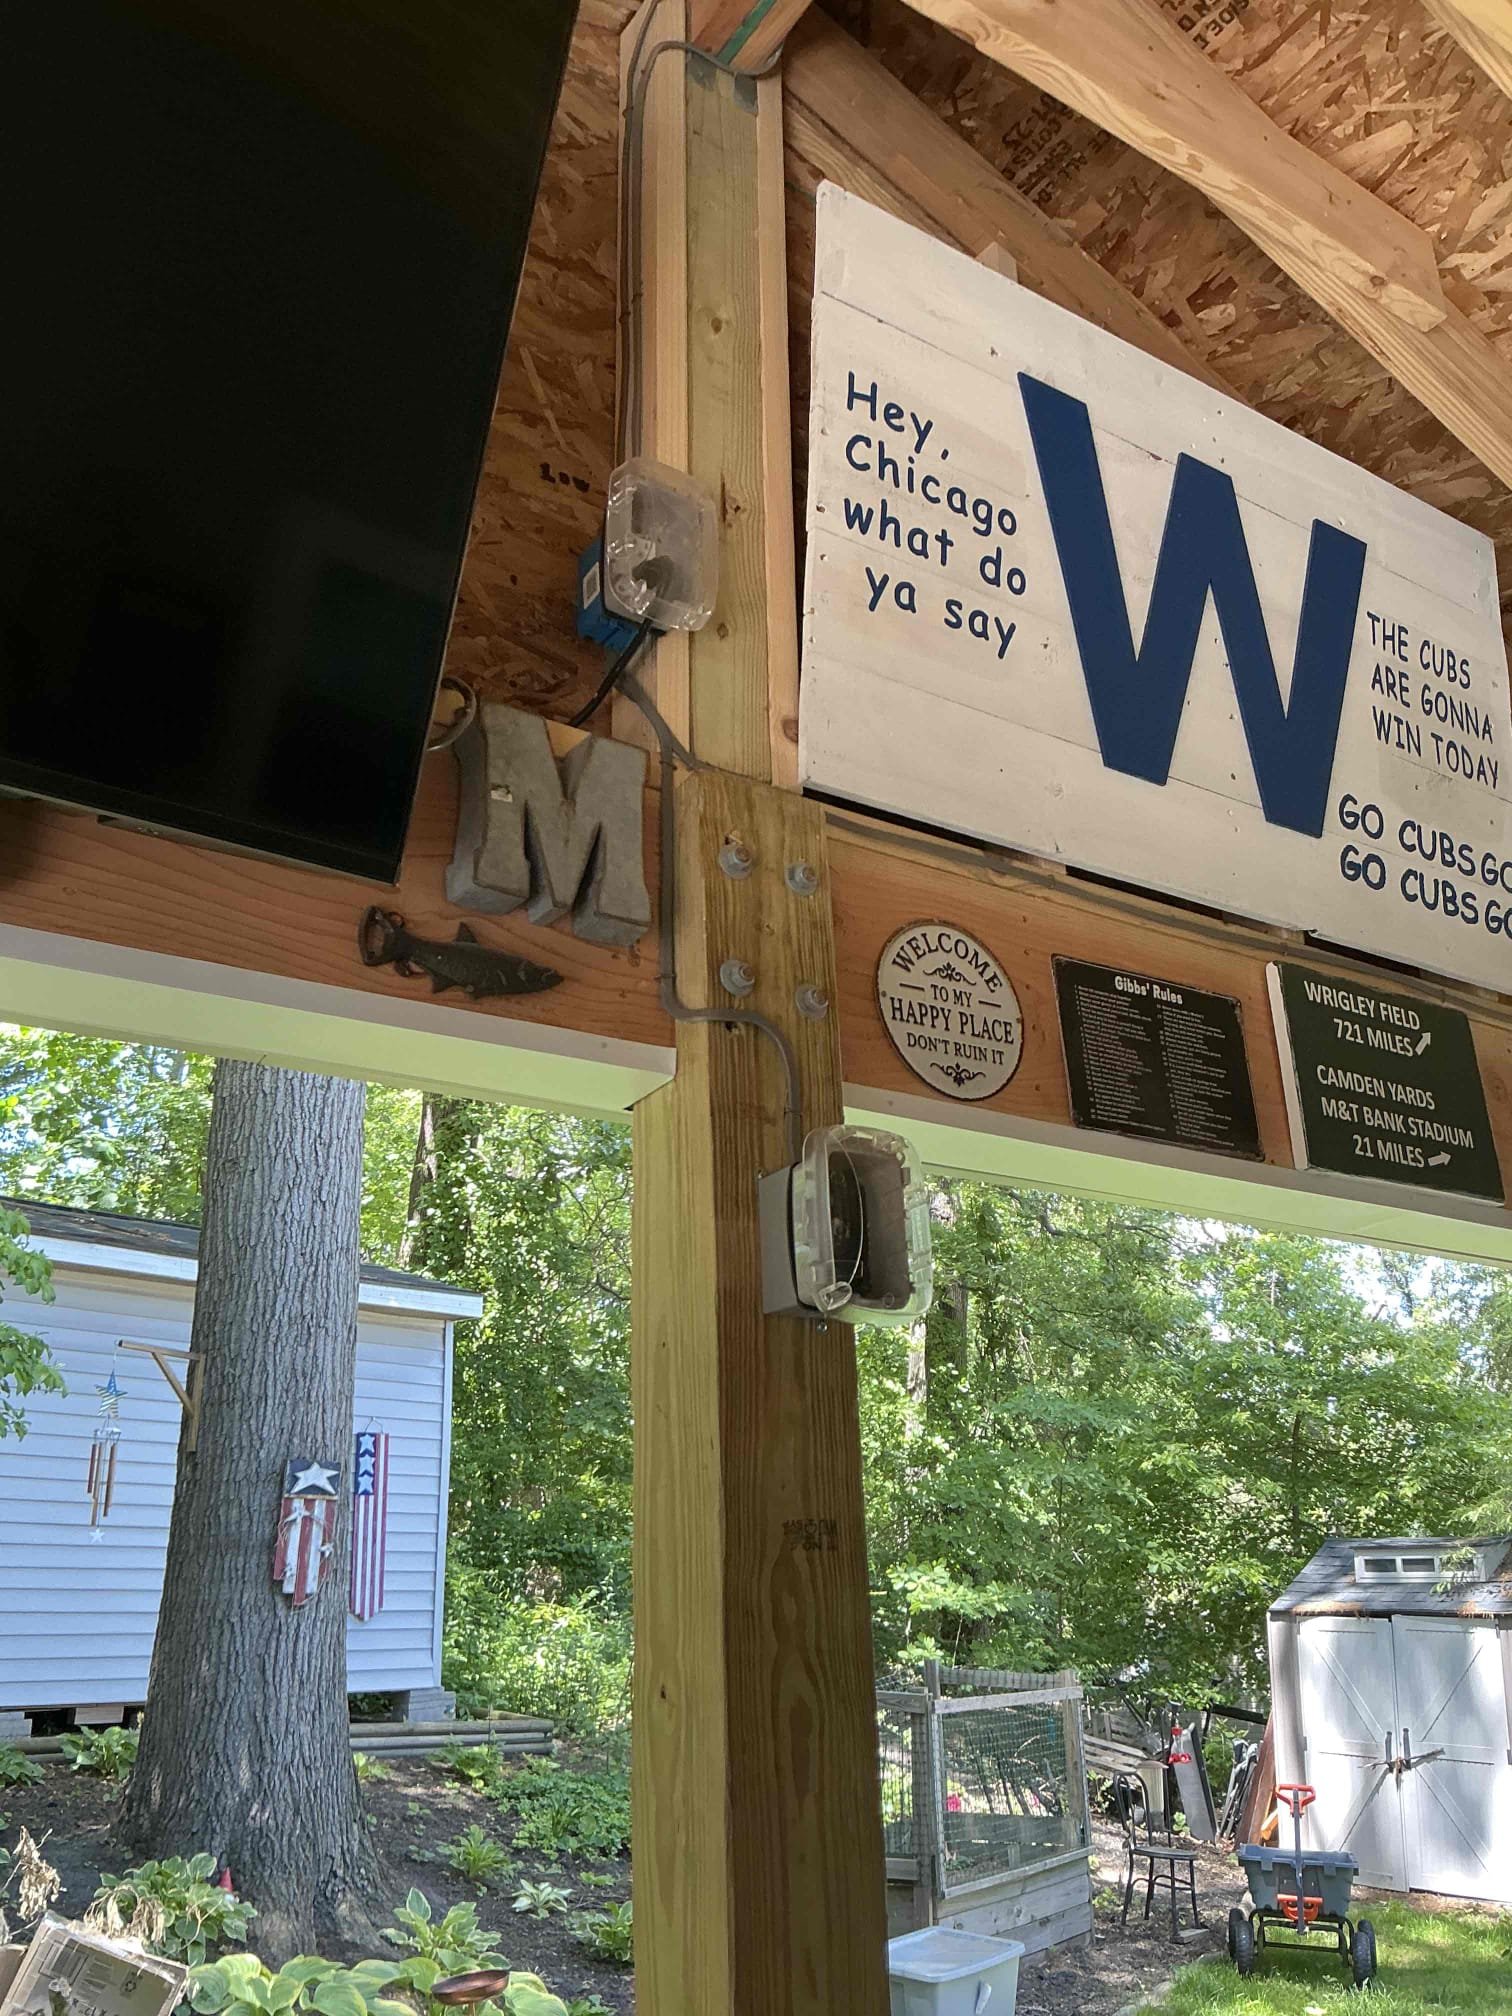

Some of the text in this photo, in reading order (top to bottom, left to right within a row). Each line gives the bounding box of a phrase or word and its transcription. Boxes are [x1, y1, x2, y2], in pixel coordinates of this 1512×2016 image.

[846, 370, 949, 460] Hey,
[845, 434, 1017, 537] Chicago
[844, 498, 1026, 596] what do
[865, 566, 1016, 659] ya say
[1017, 371, 1368, 839] W
[1367, 611, 1471, 690] THE CUBS
[1371, 663, 1493, 745] ARE GONNA
[1372, 705, 1498, 790] WIN TODAY
[444, 702, 652, 948] M
[1339, 794, 1384, 840] GO
[1399, 820, 1476, 877] CUBS
[1340, 845, 1387, 891] GO
[1400, 868, 1479, 926] CUBS
[891, 932, 1002, 994] WELCOME
[930, 984, 972, 1008] TO MY
[1114, 975, 1183, 1005] Gibbs' Rules
[889, 996, 1015, 1045] HAPPY PLACE
[1303, 980, 1421, 1030] WRIGLEY FIELD
[1333, 1018, 1414, 1057] 721 MILES
[907, 1032, 1005, 1065] DON'T RUIN IT
[1316, 1064, 1436, 1110] CAMDEN YARDS
[1321, 1096, 1474, 1149] M&T BANK STADIUM
[1352, 1134, 1425, 1168] 21 MILES
